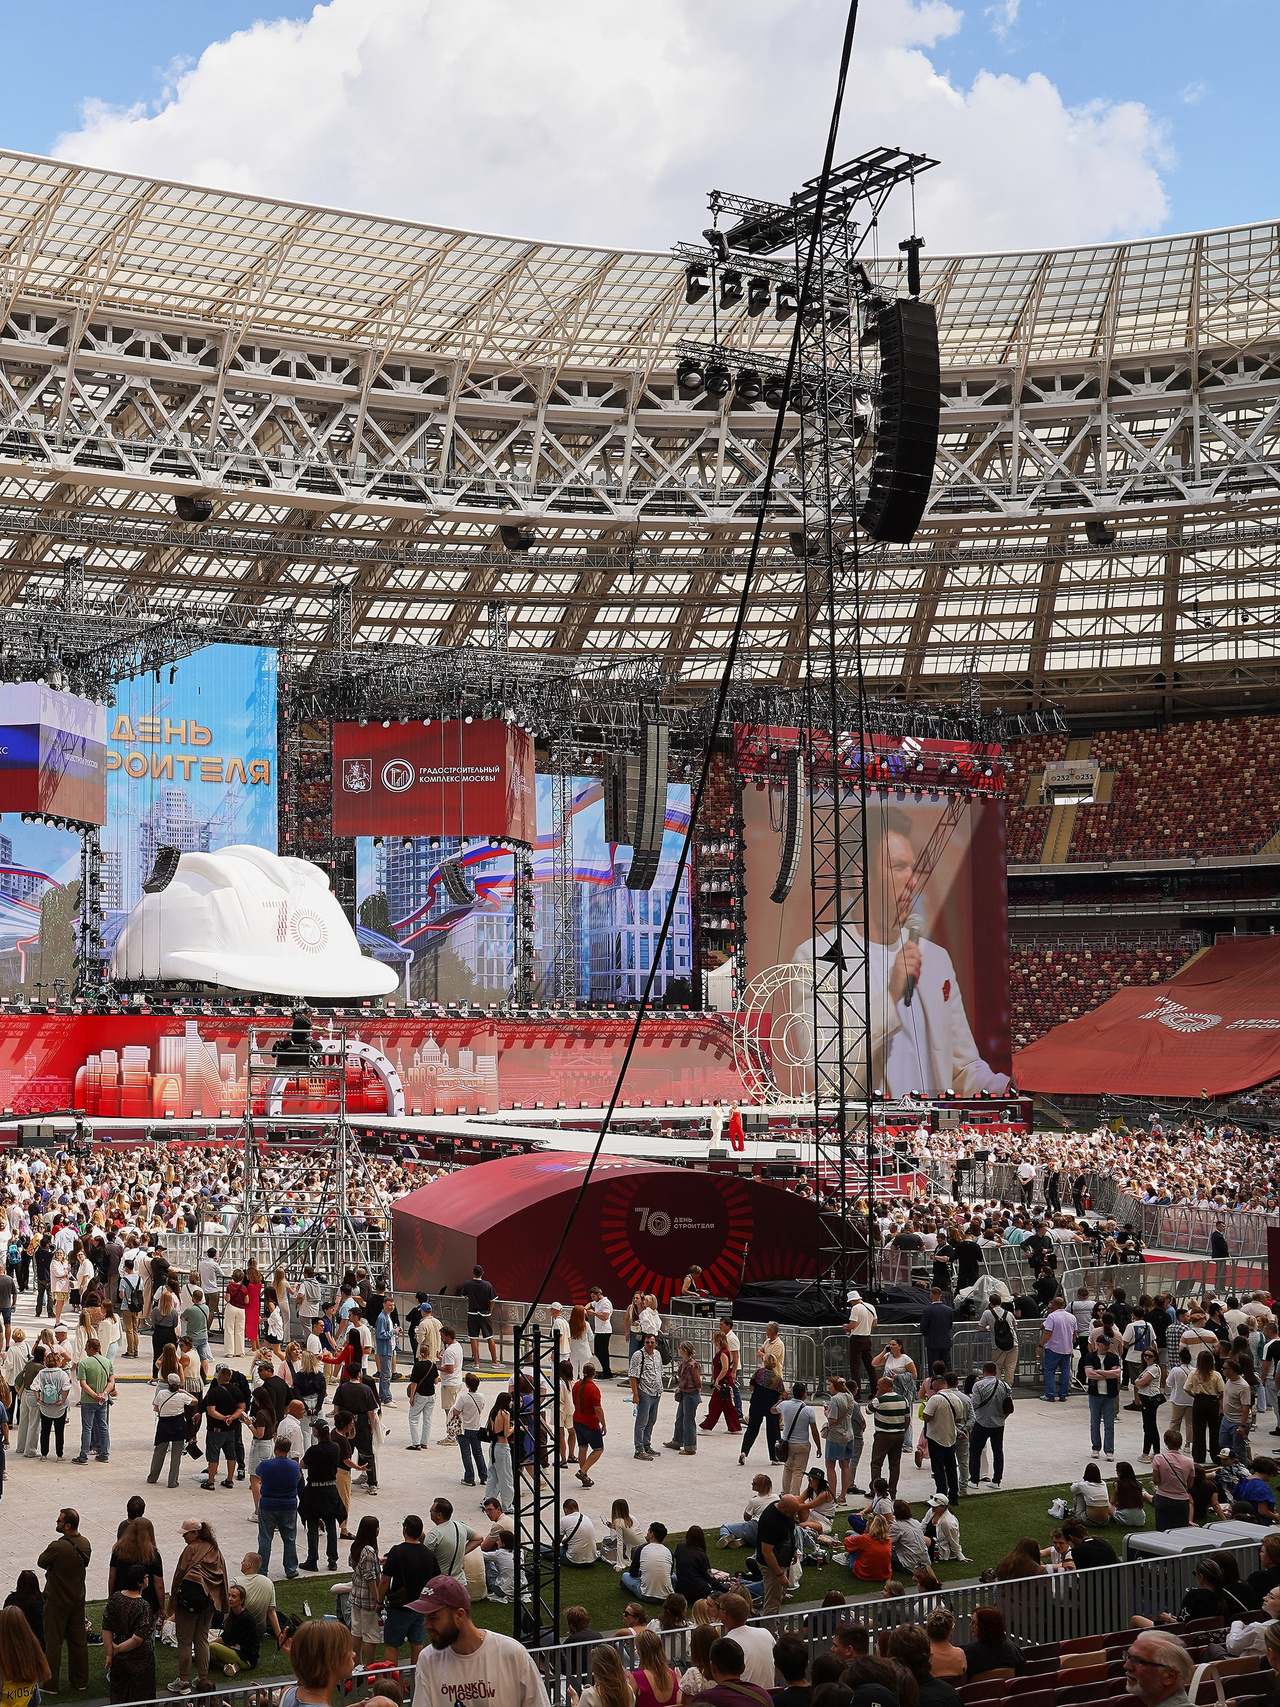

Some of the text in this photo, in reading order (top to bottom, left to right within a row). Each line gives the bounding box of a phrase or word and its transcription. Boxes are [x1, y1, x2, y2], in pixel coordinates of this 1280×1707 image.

[110, 714, 213, 746] ДЕНЬ
[107, 750, 270, 785] РОИТЕЛЯ
[419, 765, 500, 775] ГРАДОСТРОИТЕЛЬНЫЙ
[419, 775, 496, 783] КОМПЛЕКС МОСКВЫ
[262, 900, 328, 954] 70
[634, 1207, 671, 1237] 70
